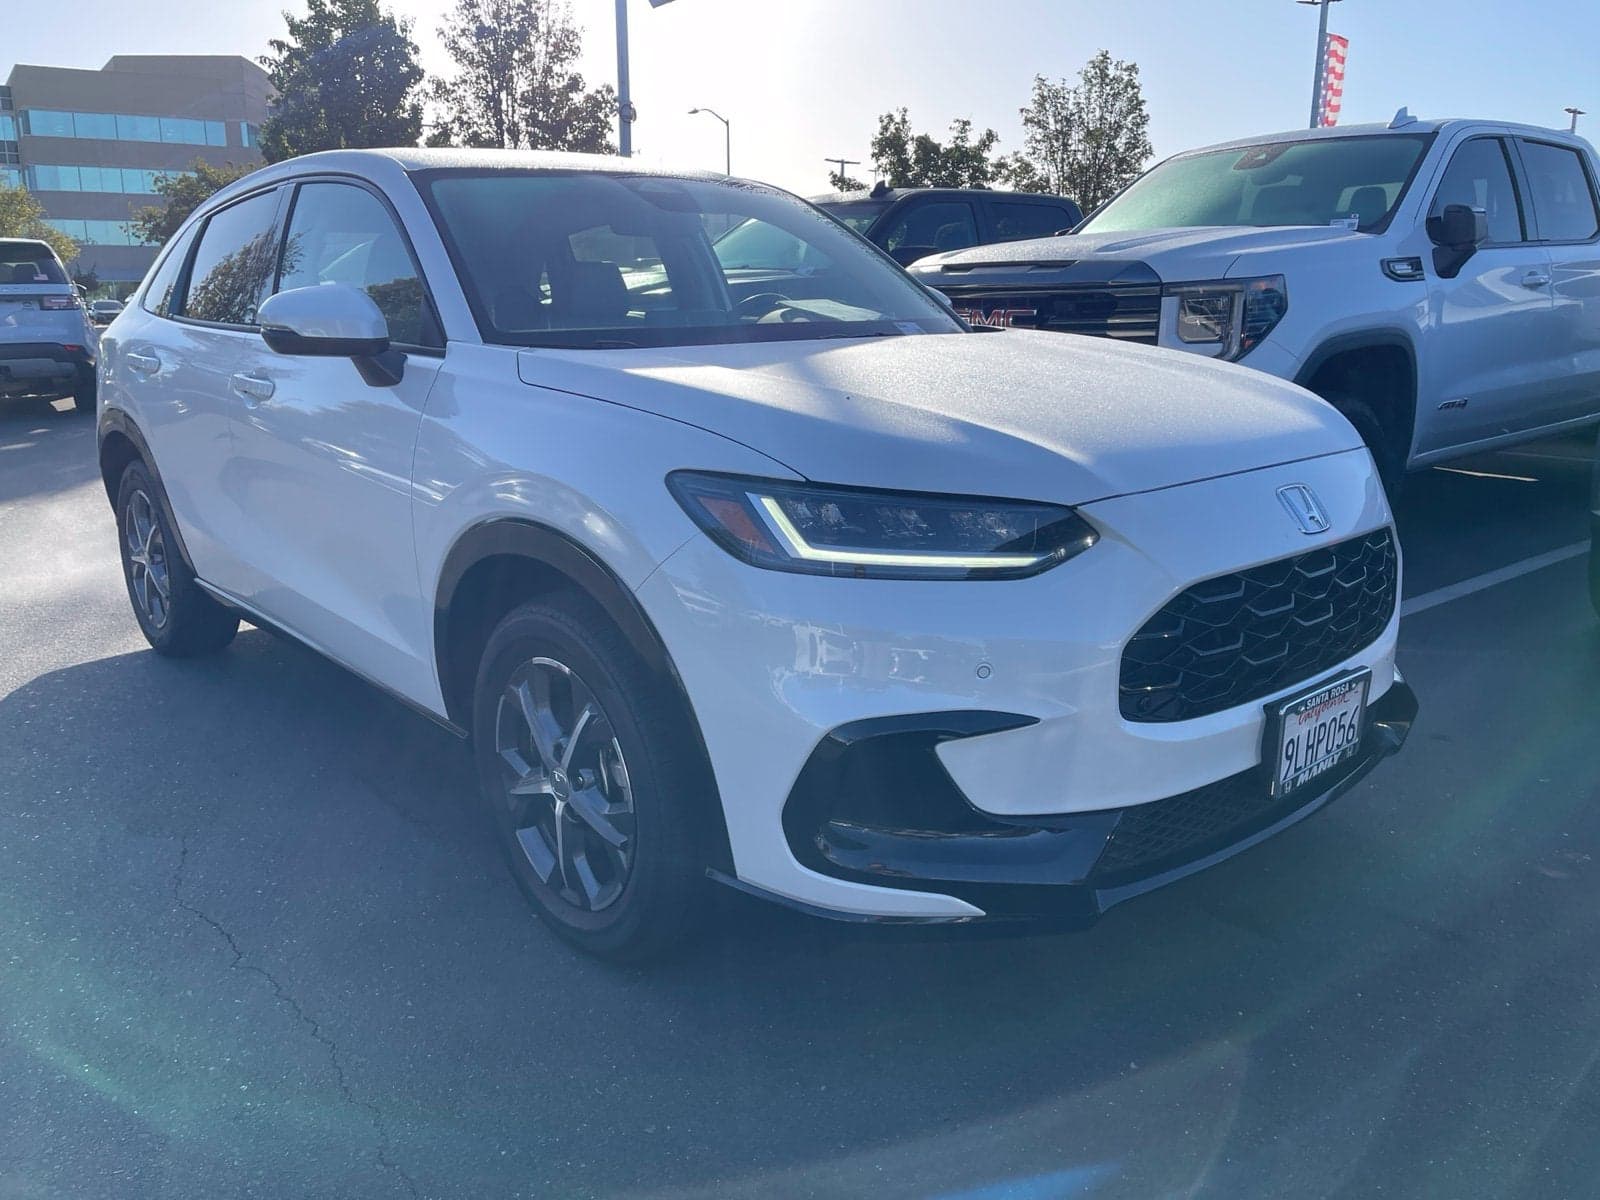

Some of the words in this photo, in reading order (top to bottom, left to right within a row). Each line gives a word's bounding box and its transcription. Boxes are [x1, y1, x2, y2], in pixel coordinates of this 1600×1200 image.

[1306, 691, 1329, 710] SANTA
[1330, 682, 1350, 698] ROSA
[1283, 704, 1360, 781] 9LHP056
